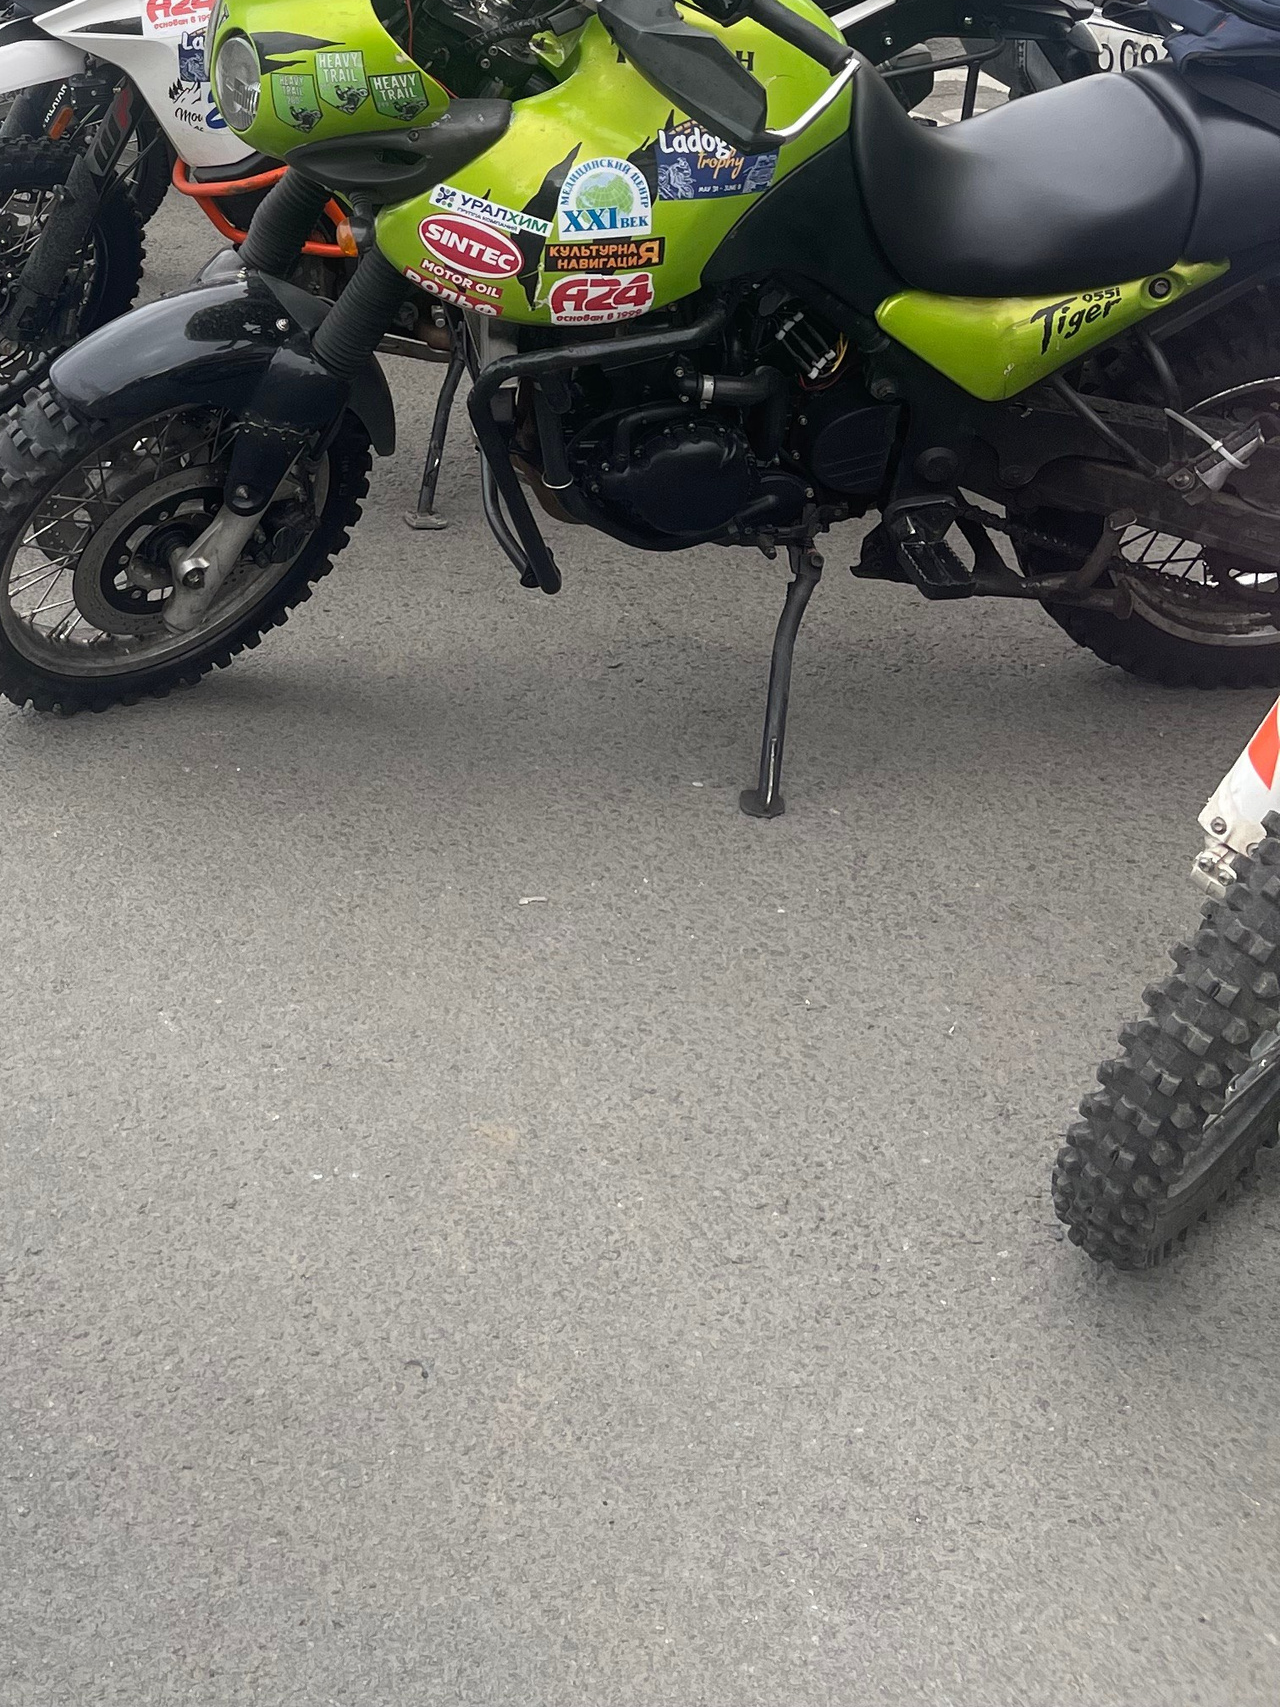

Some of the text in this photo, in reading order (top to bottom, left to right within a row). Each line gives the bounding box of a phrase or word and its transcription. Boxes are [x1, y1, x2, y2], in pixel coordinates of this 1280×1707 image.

[320, 53, 358, 68] HEAVY
[324, 68, 358, 82] TRAIL
[373, 74, 416, 90] HEAVY
[379, 86, 417, 101] TRAIL
[658, 127, 734, 159] Ladog
[560, 159, 650, 208] МЕДИЦИНСКИЙ ЦЕНТР
[461, 194, 549, 234] УРАЛХИМ
[562, 208, 648, 233] XXI ВЕК
[425, 223, 515, 270] SINTEC
[421, 259, 499, 298] MOTOR OIL
[1030, 296, 1122, 355] Tiger
